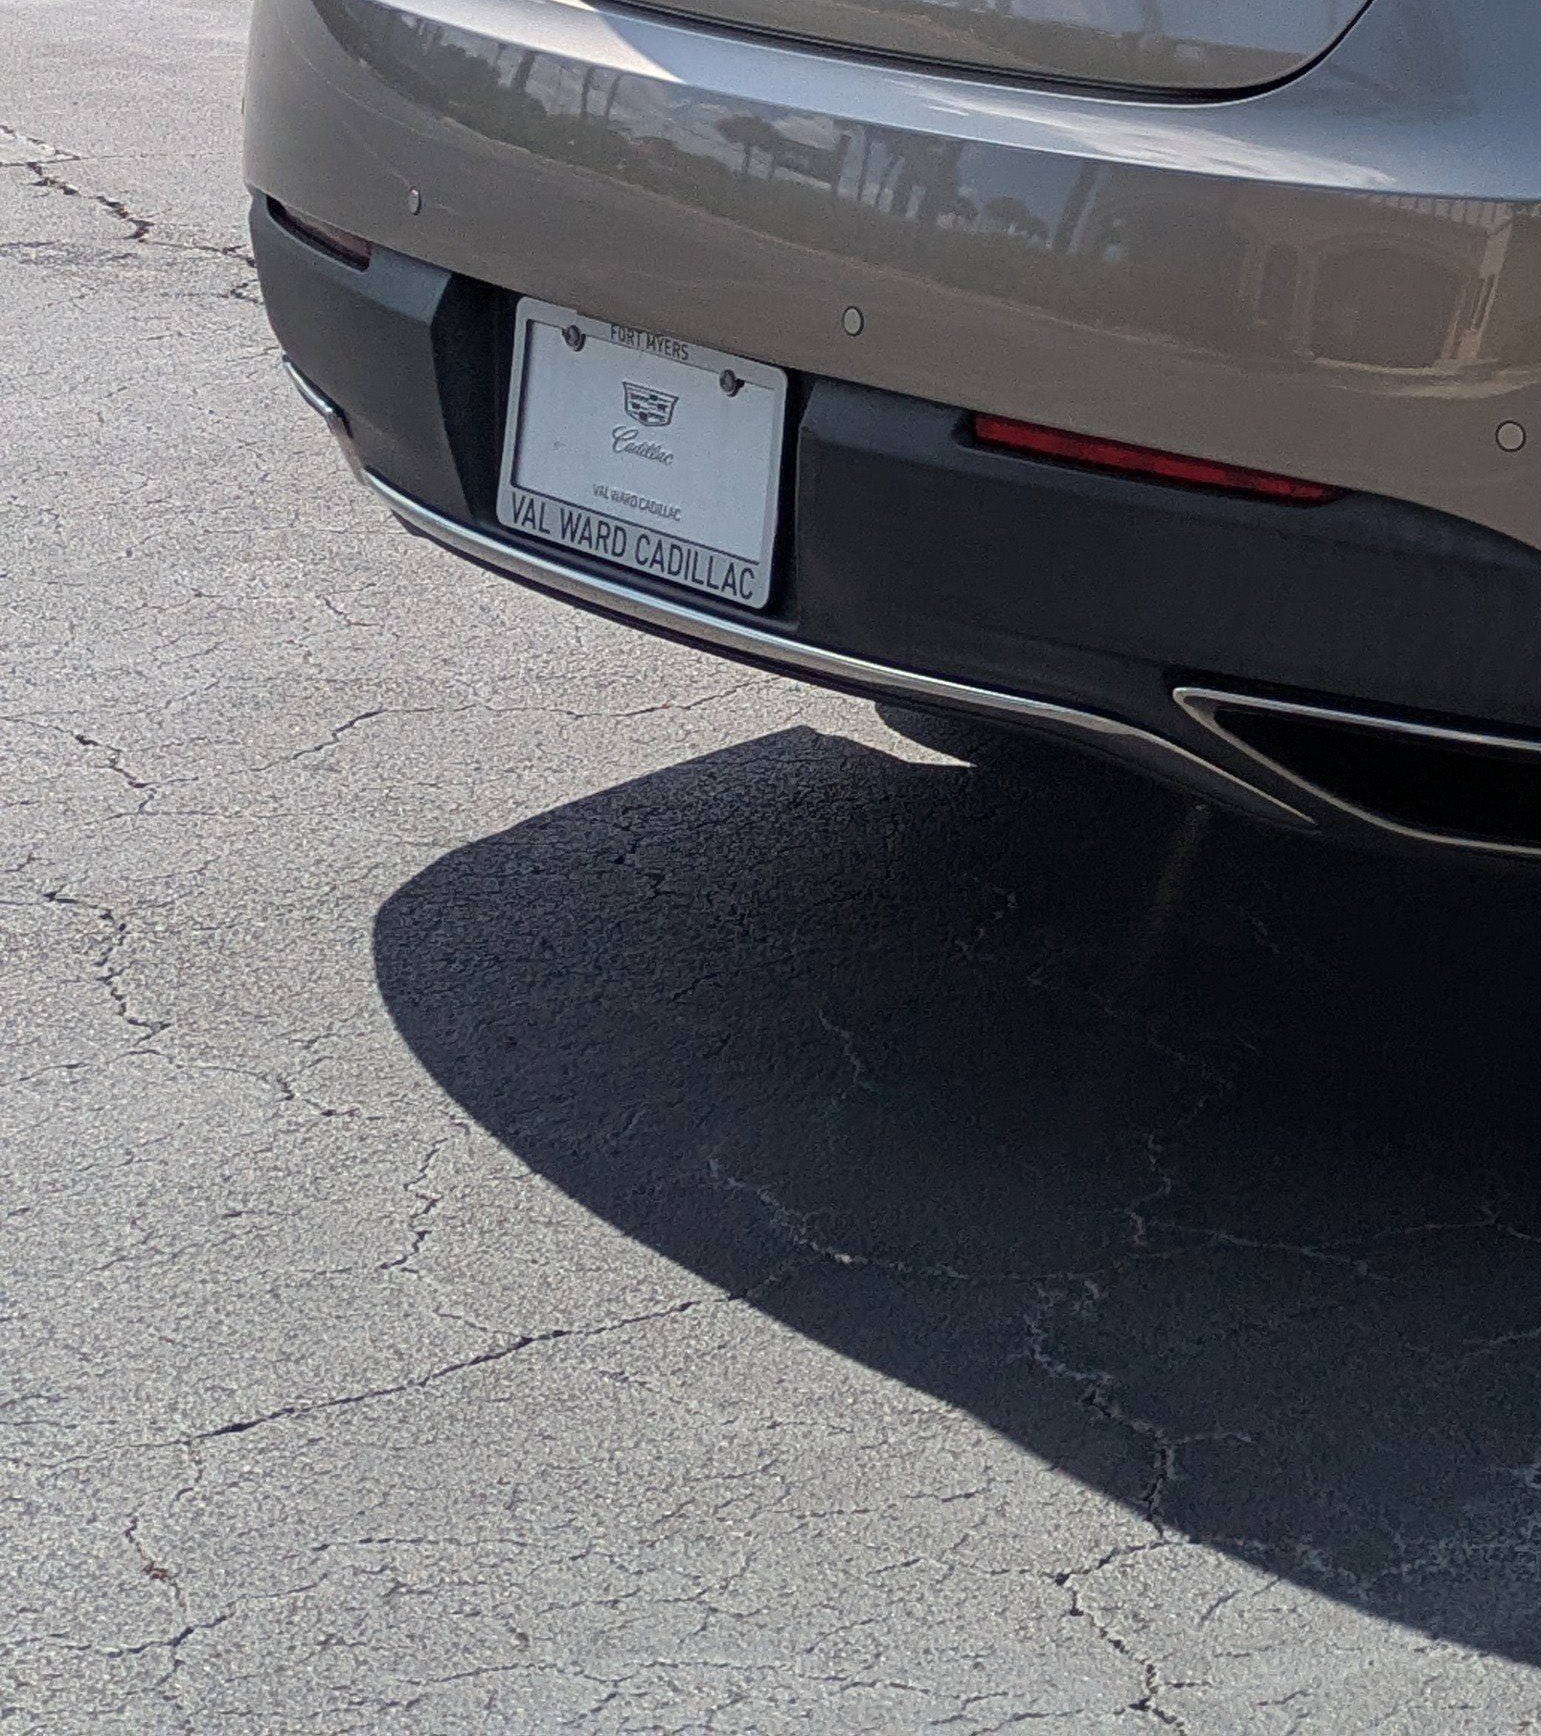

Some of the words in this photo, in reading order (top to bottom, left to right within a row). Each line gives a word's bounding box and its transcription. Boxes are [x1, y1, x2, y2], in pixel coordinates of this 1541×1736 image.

[610, 324, 647, 350] FORT
[645, 331, 689, 361] MYERS
[612, 426, 674, 465] Cadillac
[592, 484, 609, 500] VAL
[638, 497, 681, 521] CADILLAC
[511, 492, 551, 534] VAL
[560, 508, 627, 557] WARD
[635, 534, 755, 600] CADILLAC
